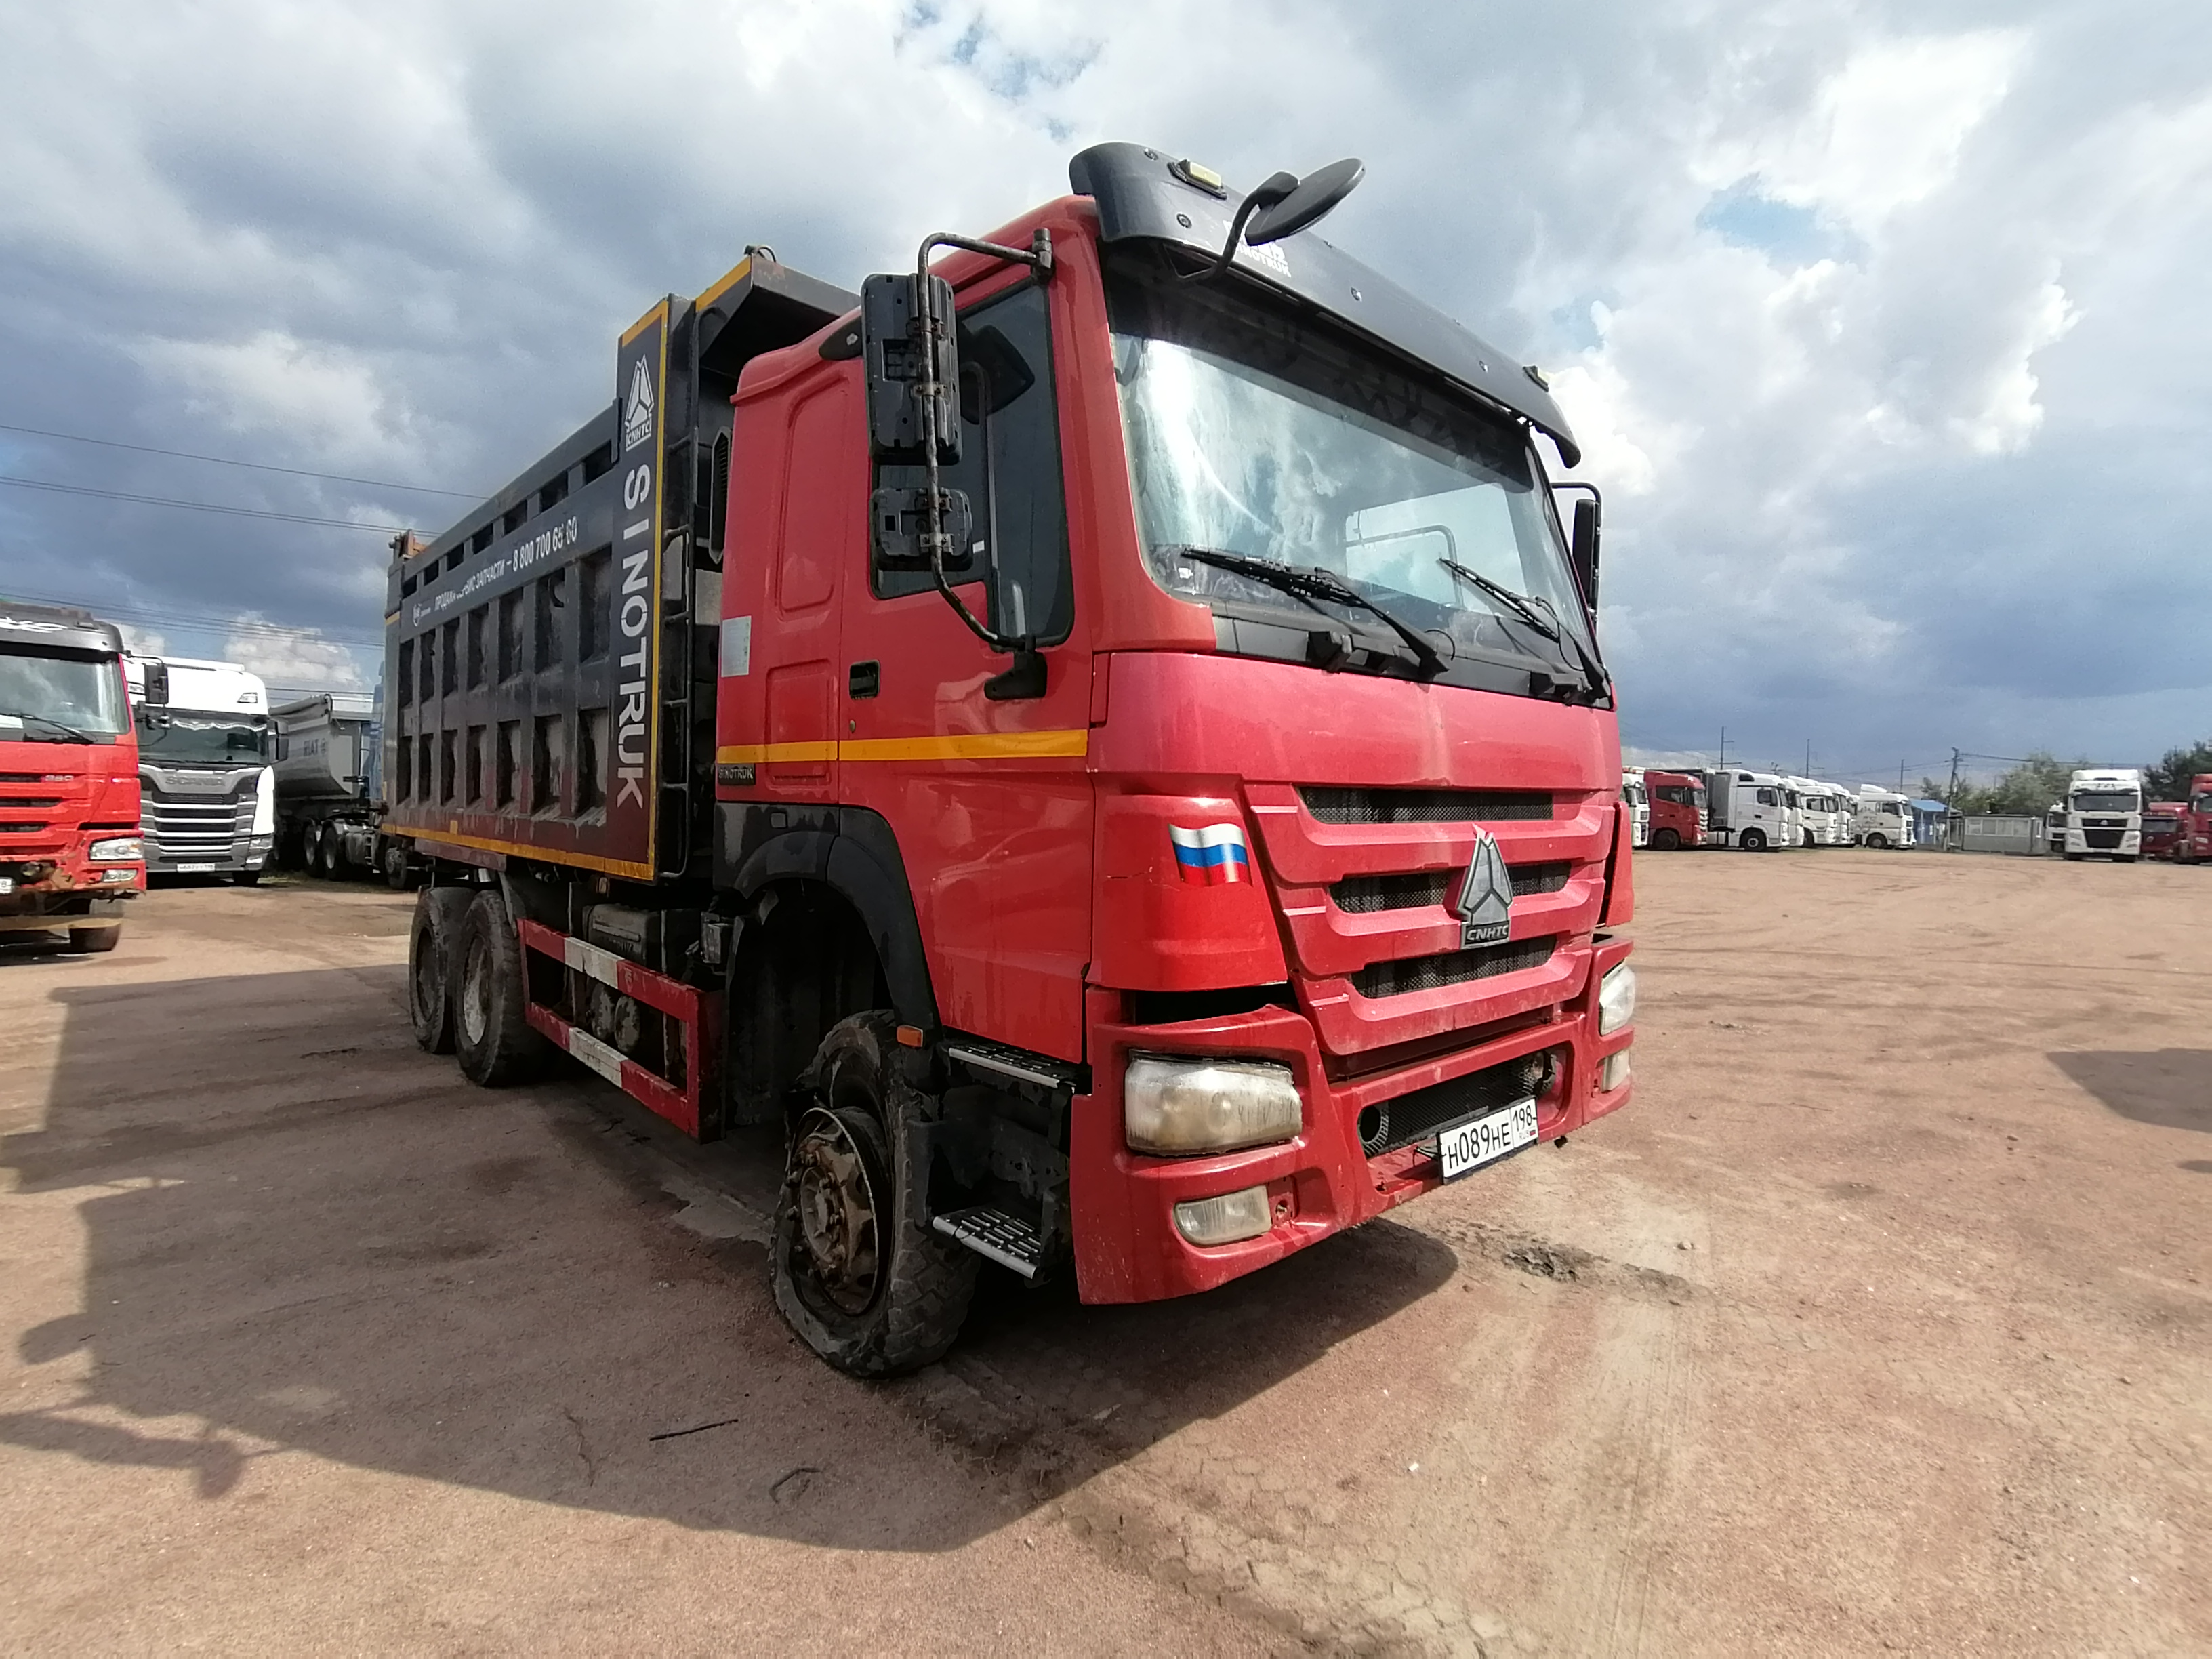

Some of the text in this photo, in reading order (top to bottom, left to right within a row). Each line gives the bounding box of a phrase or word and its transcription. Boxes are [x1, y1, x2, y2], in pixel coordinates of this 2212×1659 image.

[1235, 241, 1292, 278] INOTRUK
[626, 420, 650, 445] CNHTC
[512, 548, 518, 572] 8
[519, 539, 534, 569] 800
[535, 530, 551, 560] 700
[552, 523, 564, 552] 65
[566, 516, 577, 545] 60
[617, 464, 651, 809] SINOTRUK
[718, 767, 754, 779] SINOTRUK
[1467, 924, 1509, 941] CNHTC
[1512, 1105, 1533, 1132] 198
